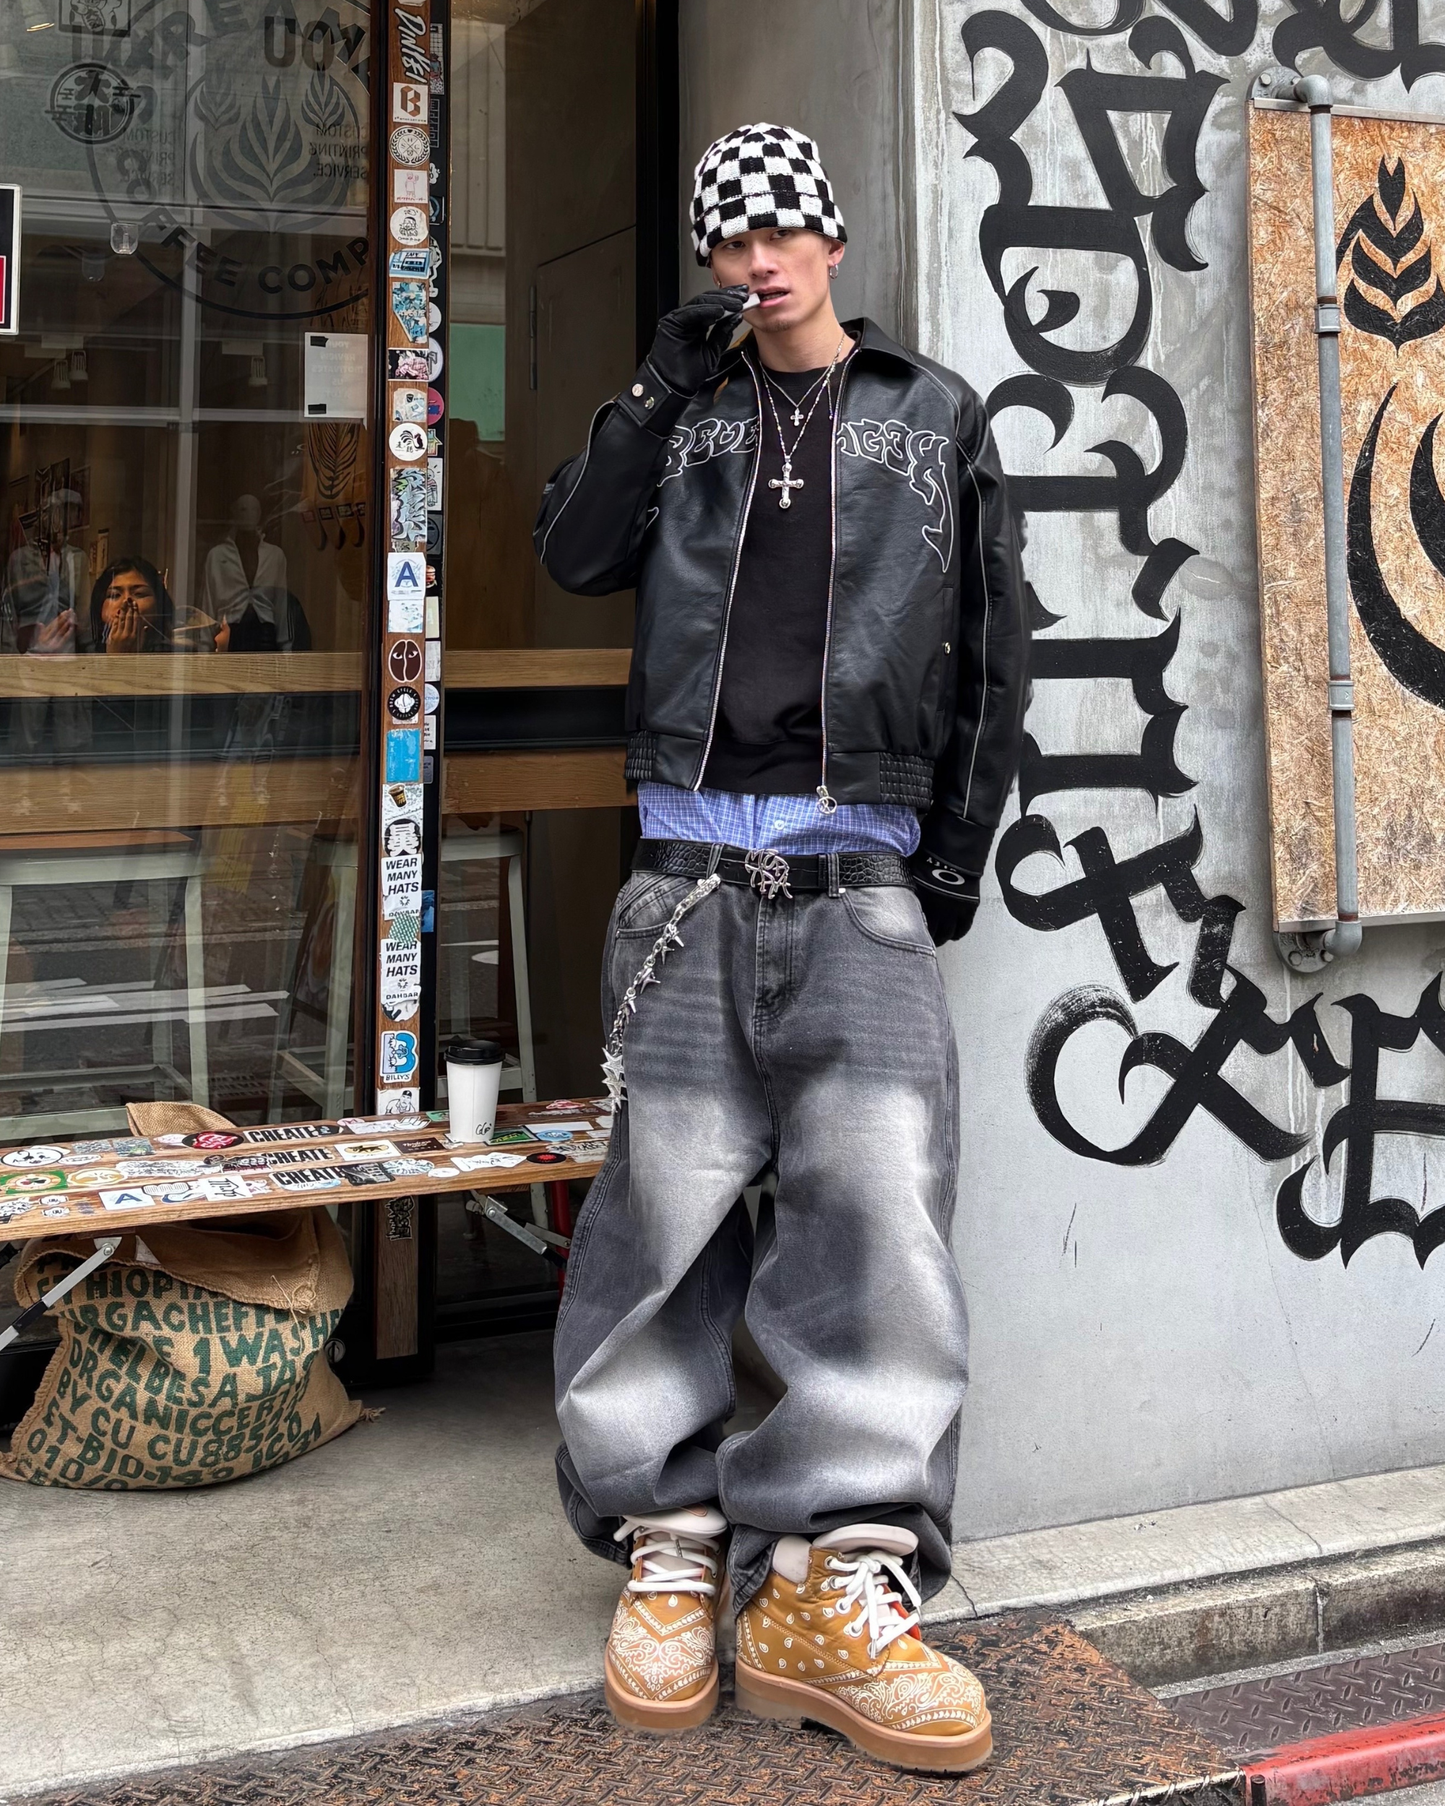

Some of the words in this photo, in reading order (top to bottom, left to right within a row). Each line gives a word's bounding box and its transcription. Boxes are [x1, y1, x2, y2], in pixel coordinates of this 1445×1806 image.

[385, 857, 418, 870] WEAR
[387, 870, 418, 882] MANY
[388, 882, 419, 895] HATS
[385, 941, 418, 952] WEAR
[386, 952, 418, 964] MANY
[386, 964, 418, 978] HATS
